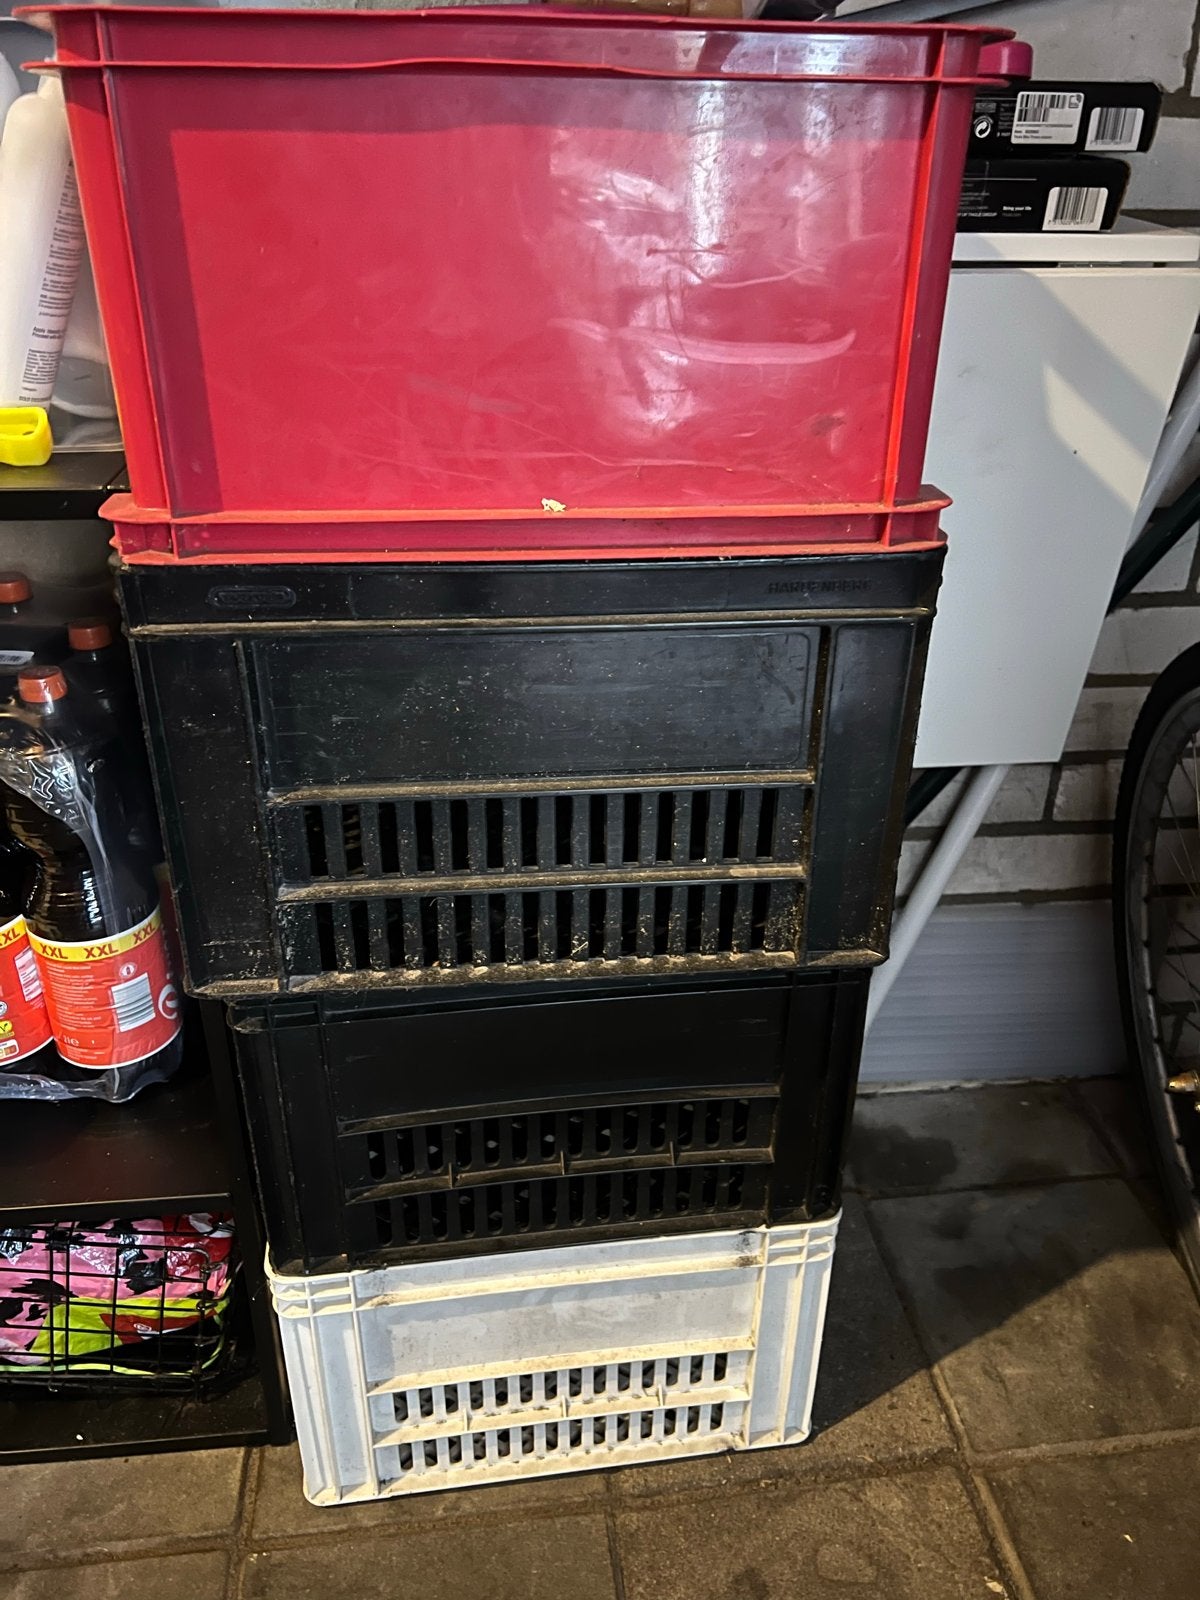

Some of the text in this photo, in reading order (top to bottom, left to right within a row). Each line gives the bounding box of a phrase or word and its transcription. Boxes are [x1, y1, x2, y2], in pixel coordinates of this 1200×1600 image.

[40, 923, 156, 960] XXL XXL XXL
